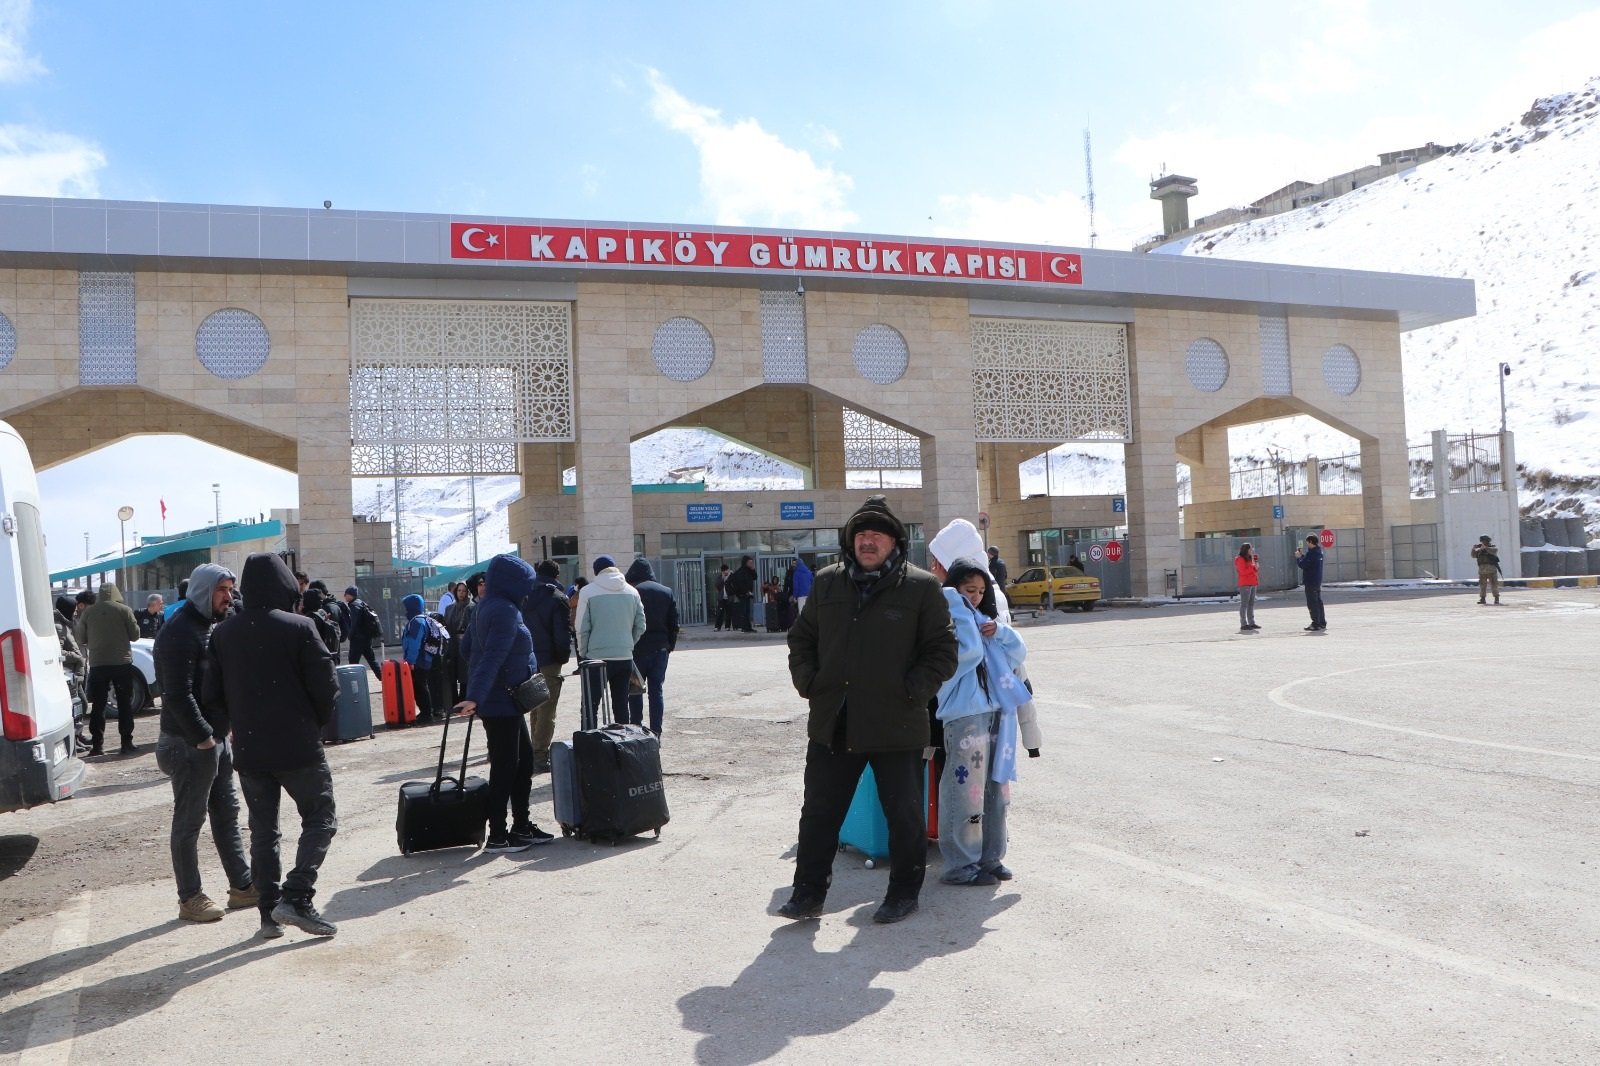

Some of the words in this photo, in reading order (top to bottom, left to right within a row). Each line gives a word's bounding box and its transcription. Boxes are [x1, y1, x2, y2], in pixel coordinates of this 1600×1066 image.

[530, 232, 729, 265] KAPIKÖY
[749, 237, 903, 272] GÜMRÜK
[915, 251, 1027, 279] KAPISI
[1115, 503, 1122, 511] 2
[1320, 535, 1334, 543] DUR
[1106, 547, 1121, 556] DUR
